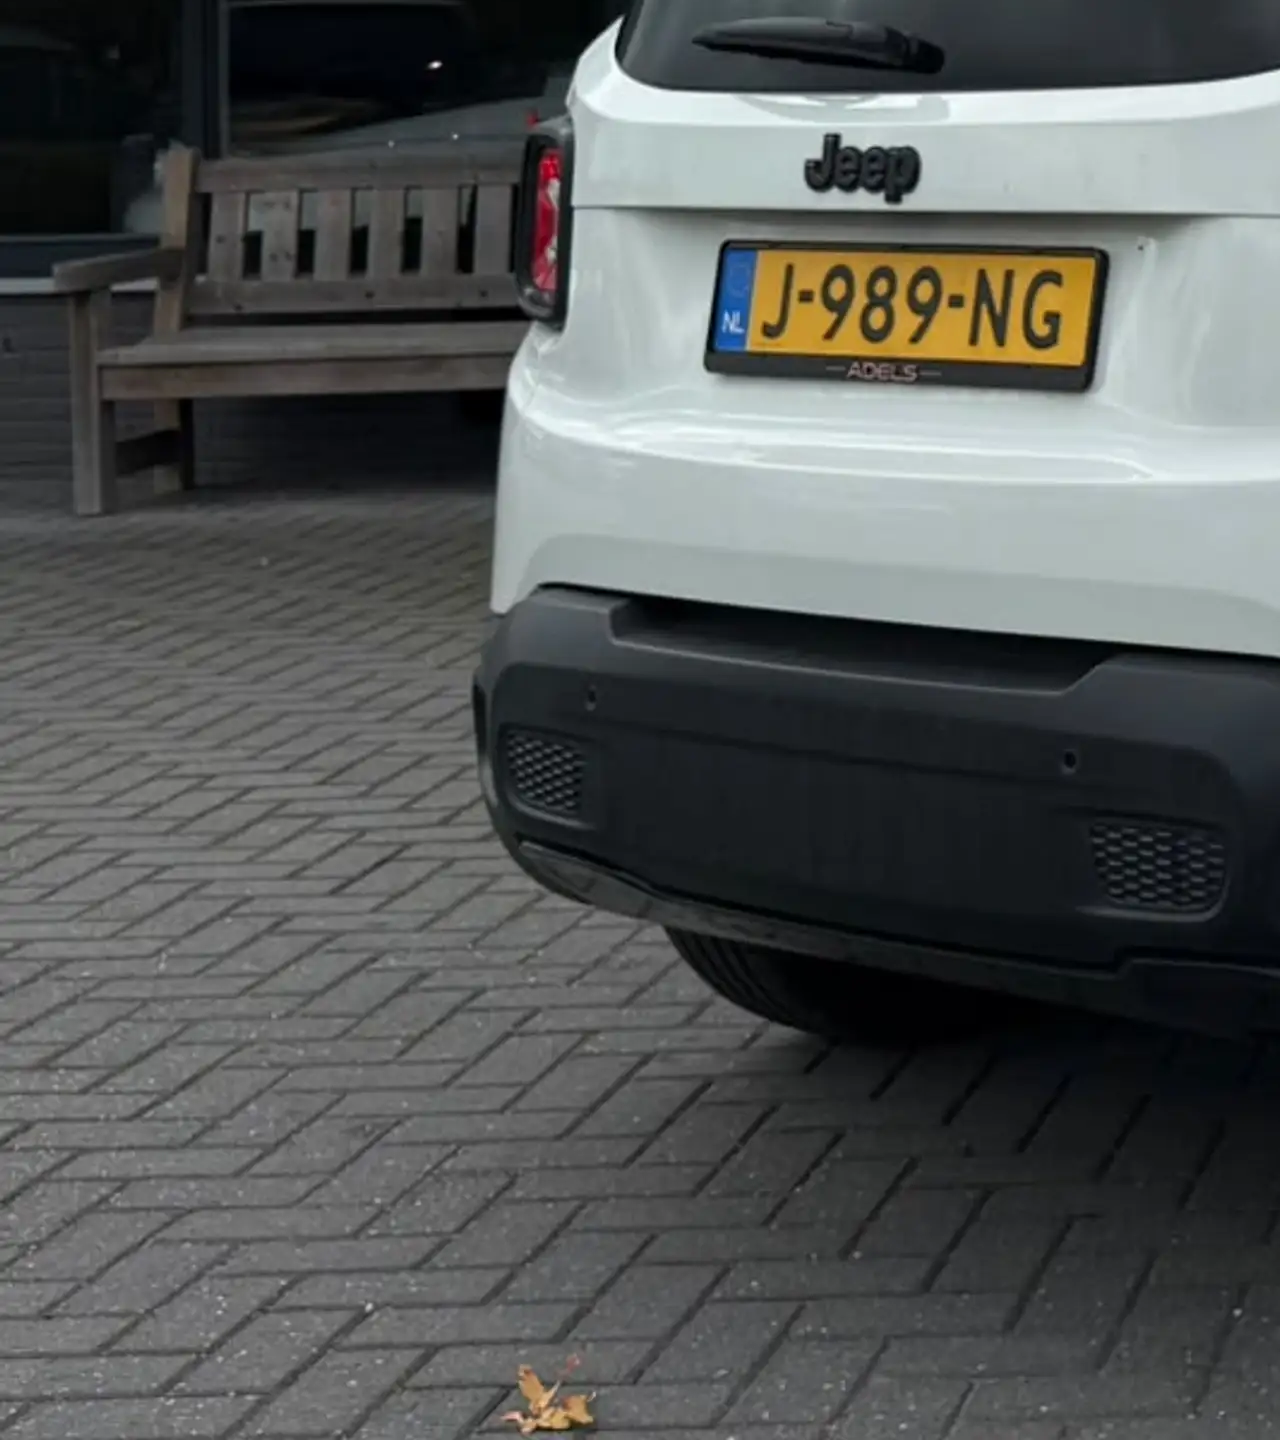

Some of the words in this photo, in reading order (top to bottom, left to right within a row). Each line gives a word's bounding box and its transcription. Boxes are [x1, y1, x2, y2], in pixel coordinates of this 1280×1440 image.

[804, 132, 921, 204] Jeep
[722, 311, 745, 334] NL
[762, 263, 1063, 349] J-989-NG
[846, 361, 918, 382] ADELS
